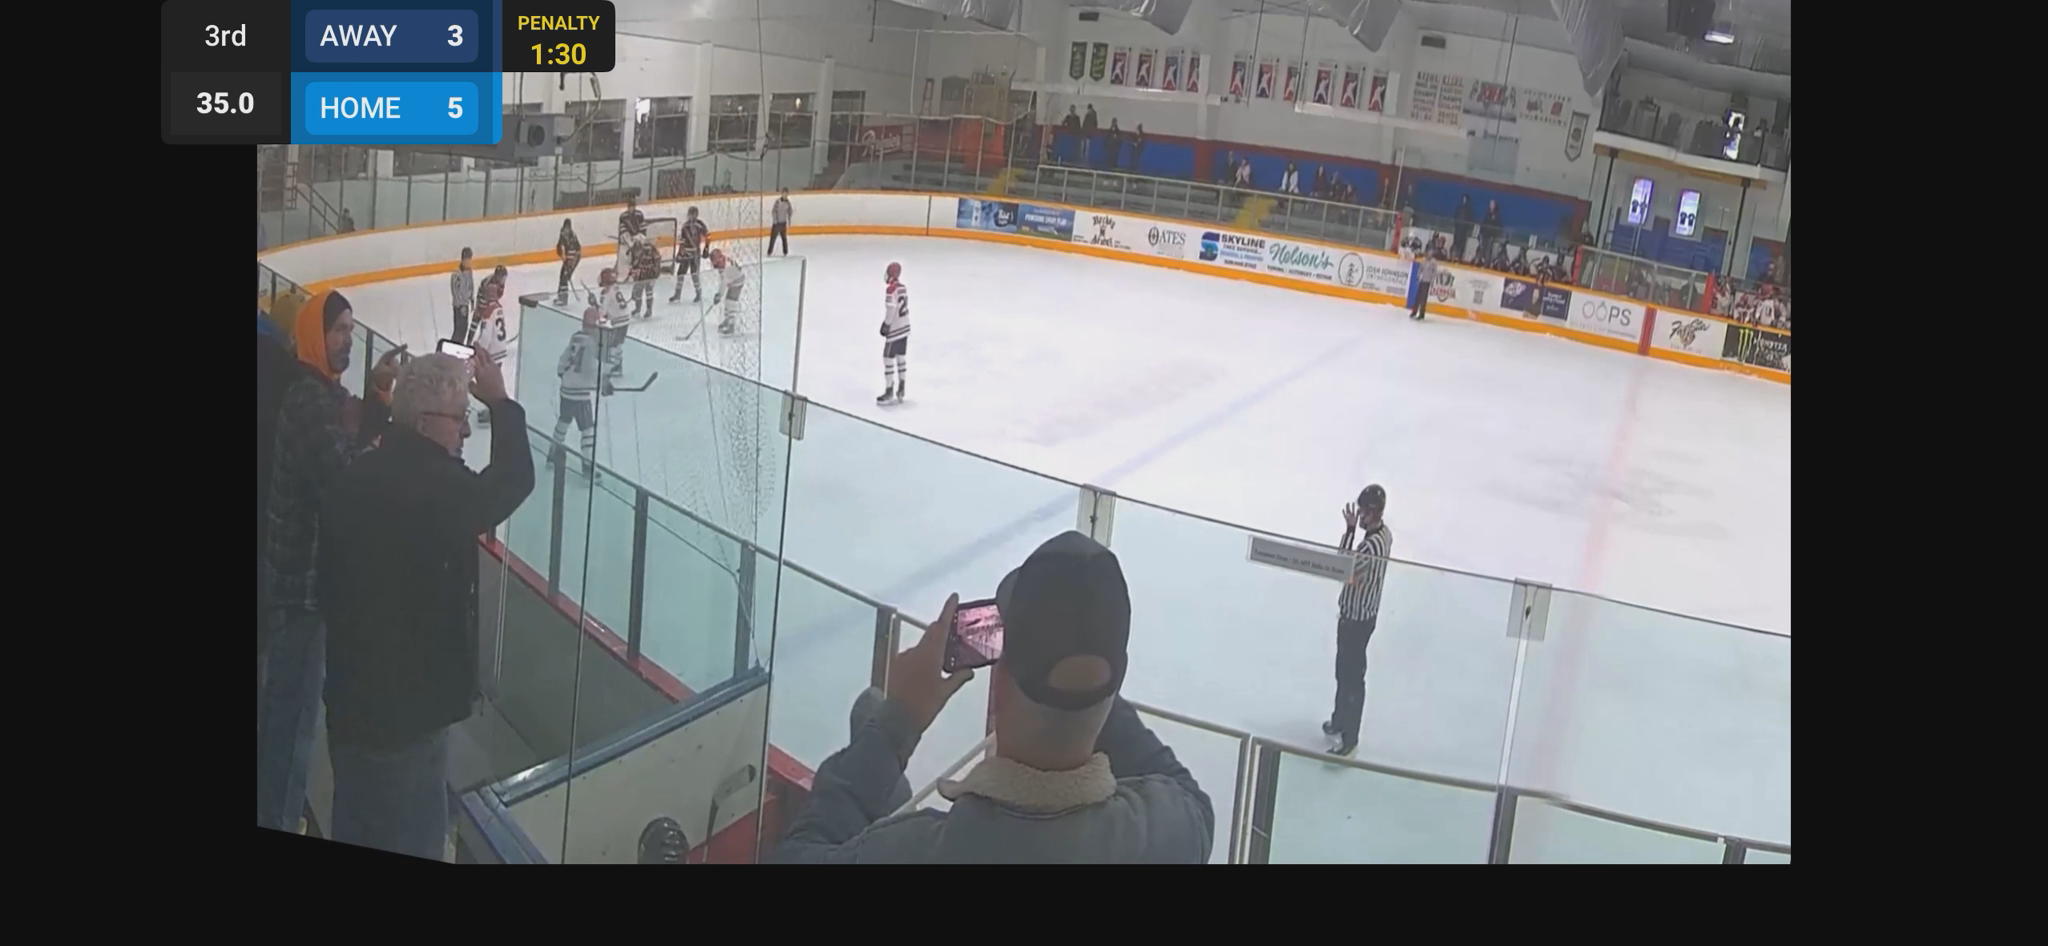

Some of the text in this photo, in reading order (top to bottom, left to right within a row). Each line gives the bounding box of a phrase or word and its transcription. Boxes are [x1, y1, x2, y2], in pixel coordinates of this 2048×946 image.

[1221, 234, 1266, 249] SKYLINE
[1269, 242, 1335, 270] Nelson's
[496, 317, 506, 342] 3
